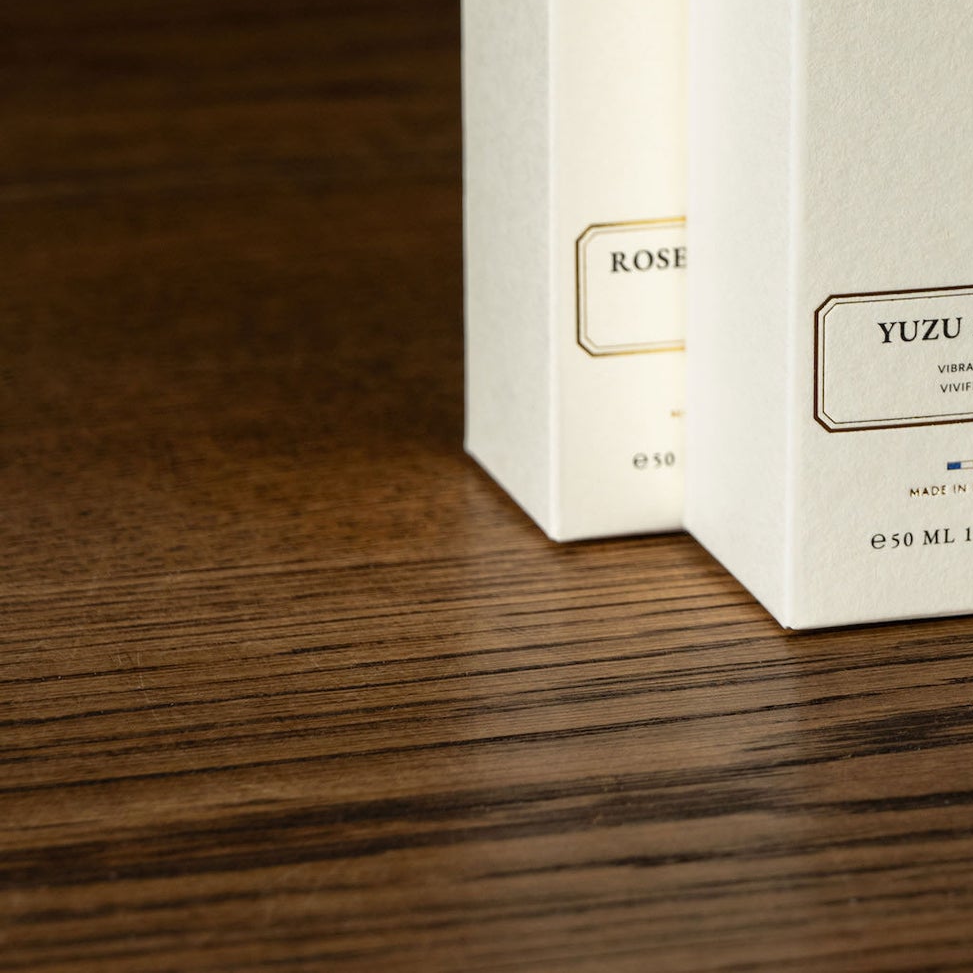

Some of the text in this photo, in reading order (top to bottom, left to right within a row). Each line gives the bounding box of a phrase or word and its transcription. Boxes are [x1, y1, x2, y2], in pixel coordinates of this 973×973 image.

[610, 246, 688, 274] ROSE
[877, 317, 963, 344] YUZU
[909, 485, 947, 498] MADE
[953, 485, 967, 494] IN
[922, 528, 955, 546] ML
